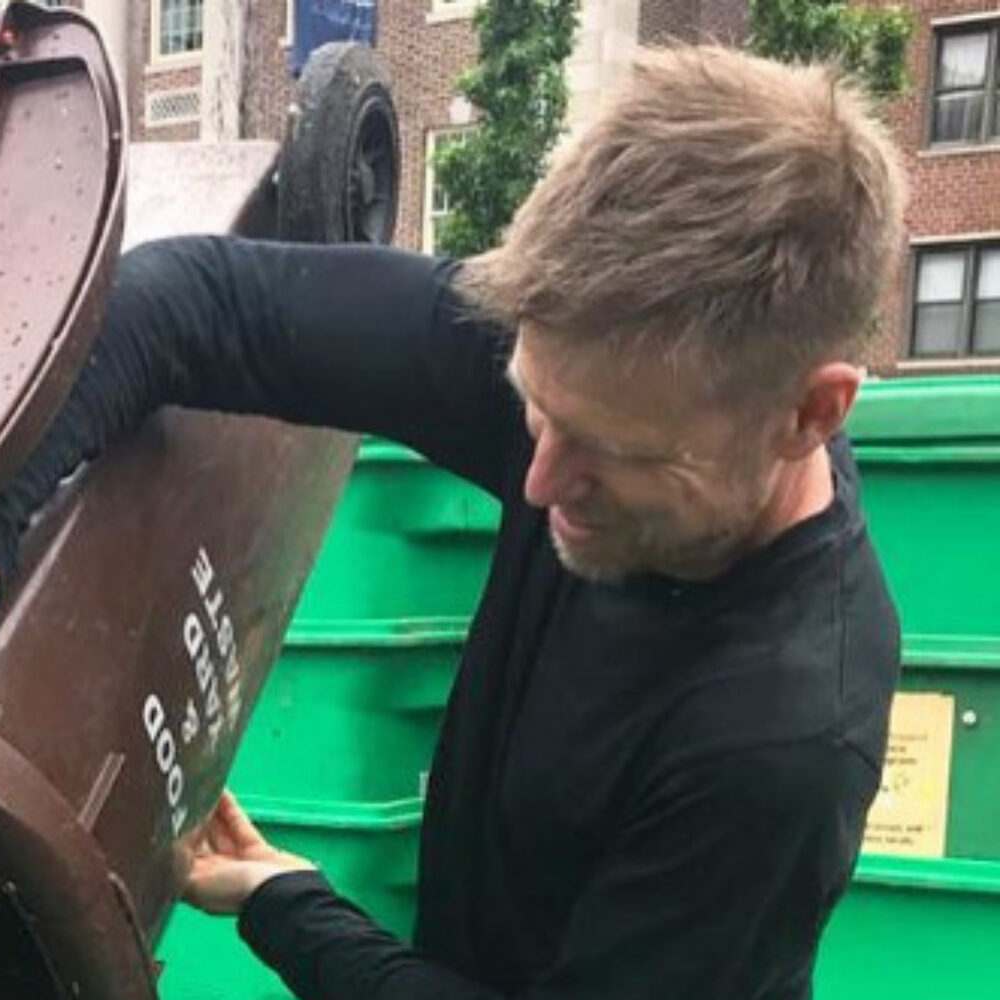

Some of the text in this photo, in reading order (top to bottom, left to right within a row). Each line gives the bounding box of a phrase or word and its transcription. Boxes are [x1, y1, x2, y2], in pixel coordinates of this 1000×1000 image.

[181, 697, 199, 744] &
[183, 612, 224, 755] YARD
[142, 694, 188, 837] FOOD
